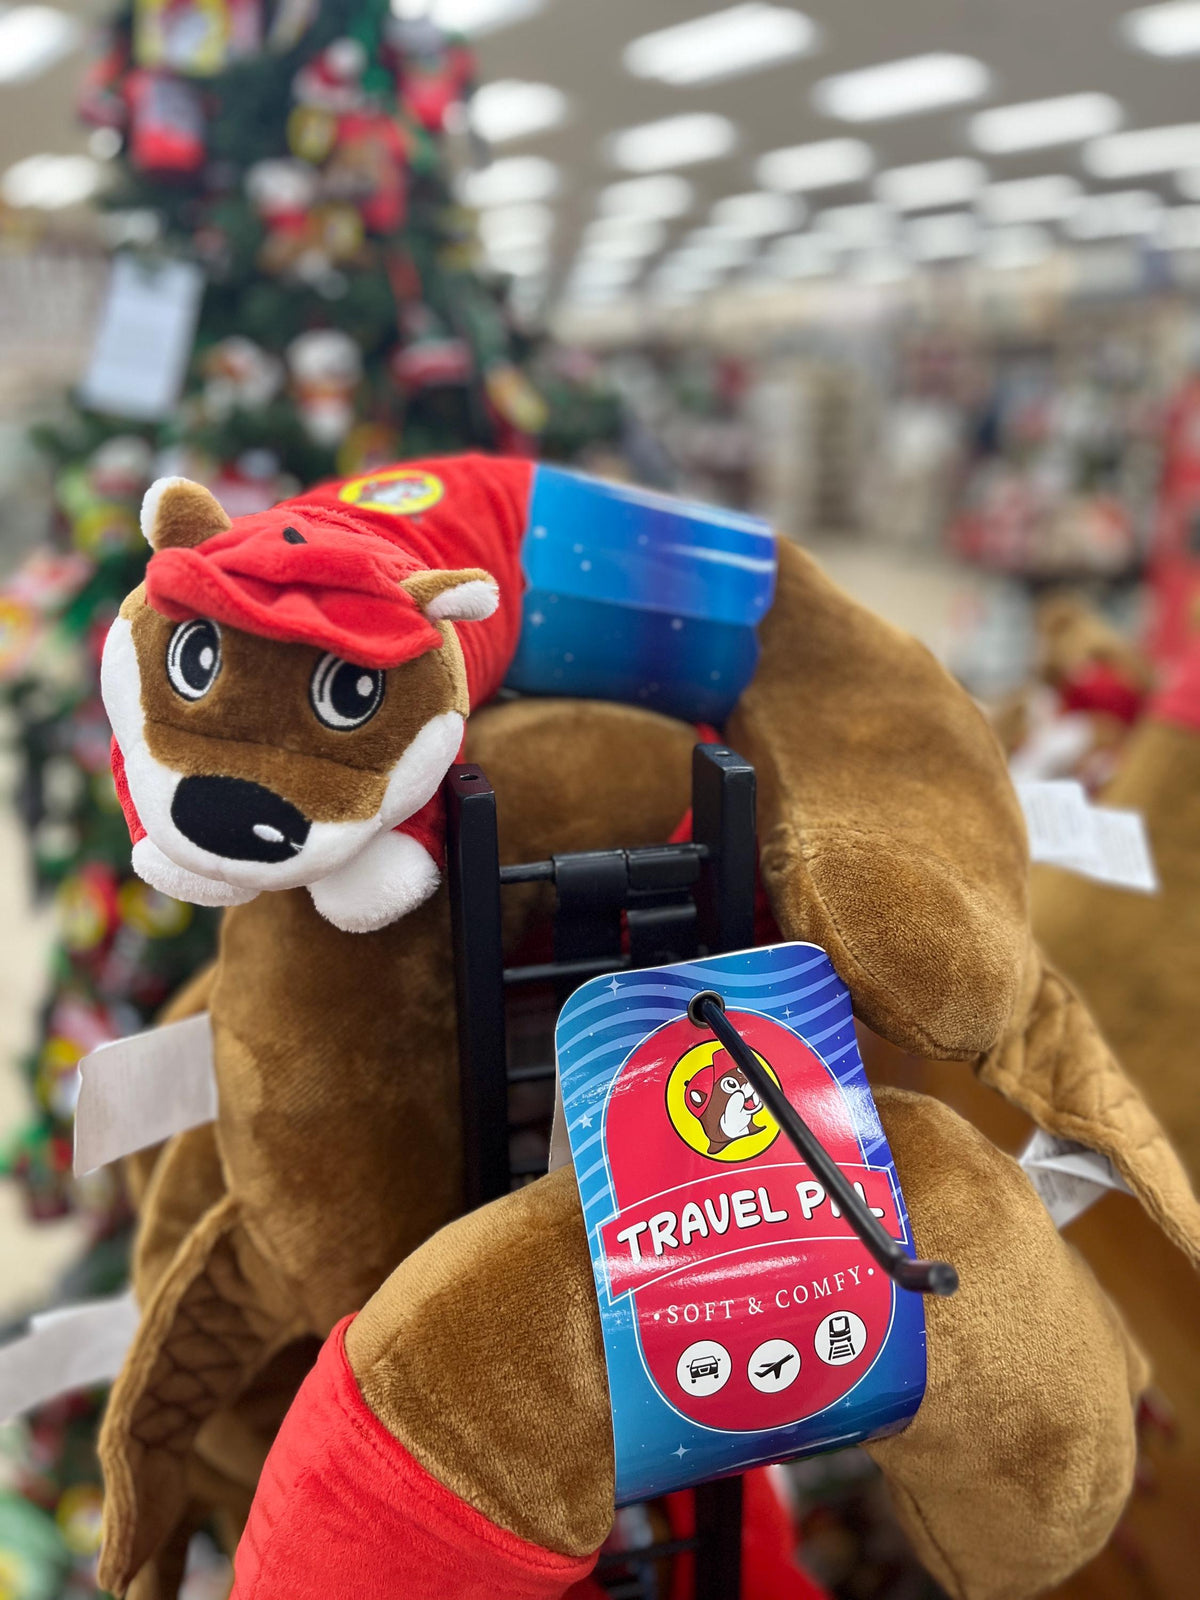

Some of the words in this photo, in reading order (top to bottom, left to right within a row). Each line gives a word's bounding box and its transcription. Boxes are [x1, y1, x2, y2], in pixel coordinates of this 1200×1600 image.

[616, 1186, 788, 1264] TRAVEL
[795, 1180, 885, 1219] PL
[667, 1299, 735, 1324] SOFT
[748, 1297, 764, 1315] &
[775, 1265, 862, 1309] COMFY
